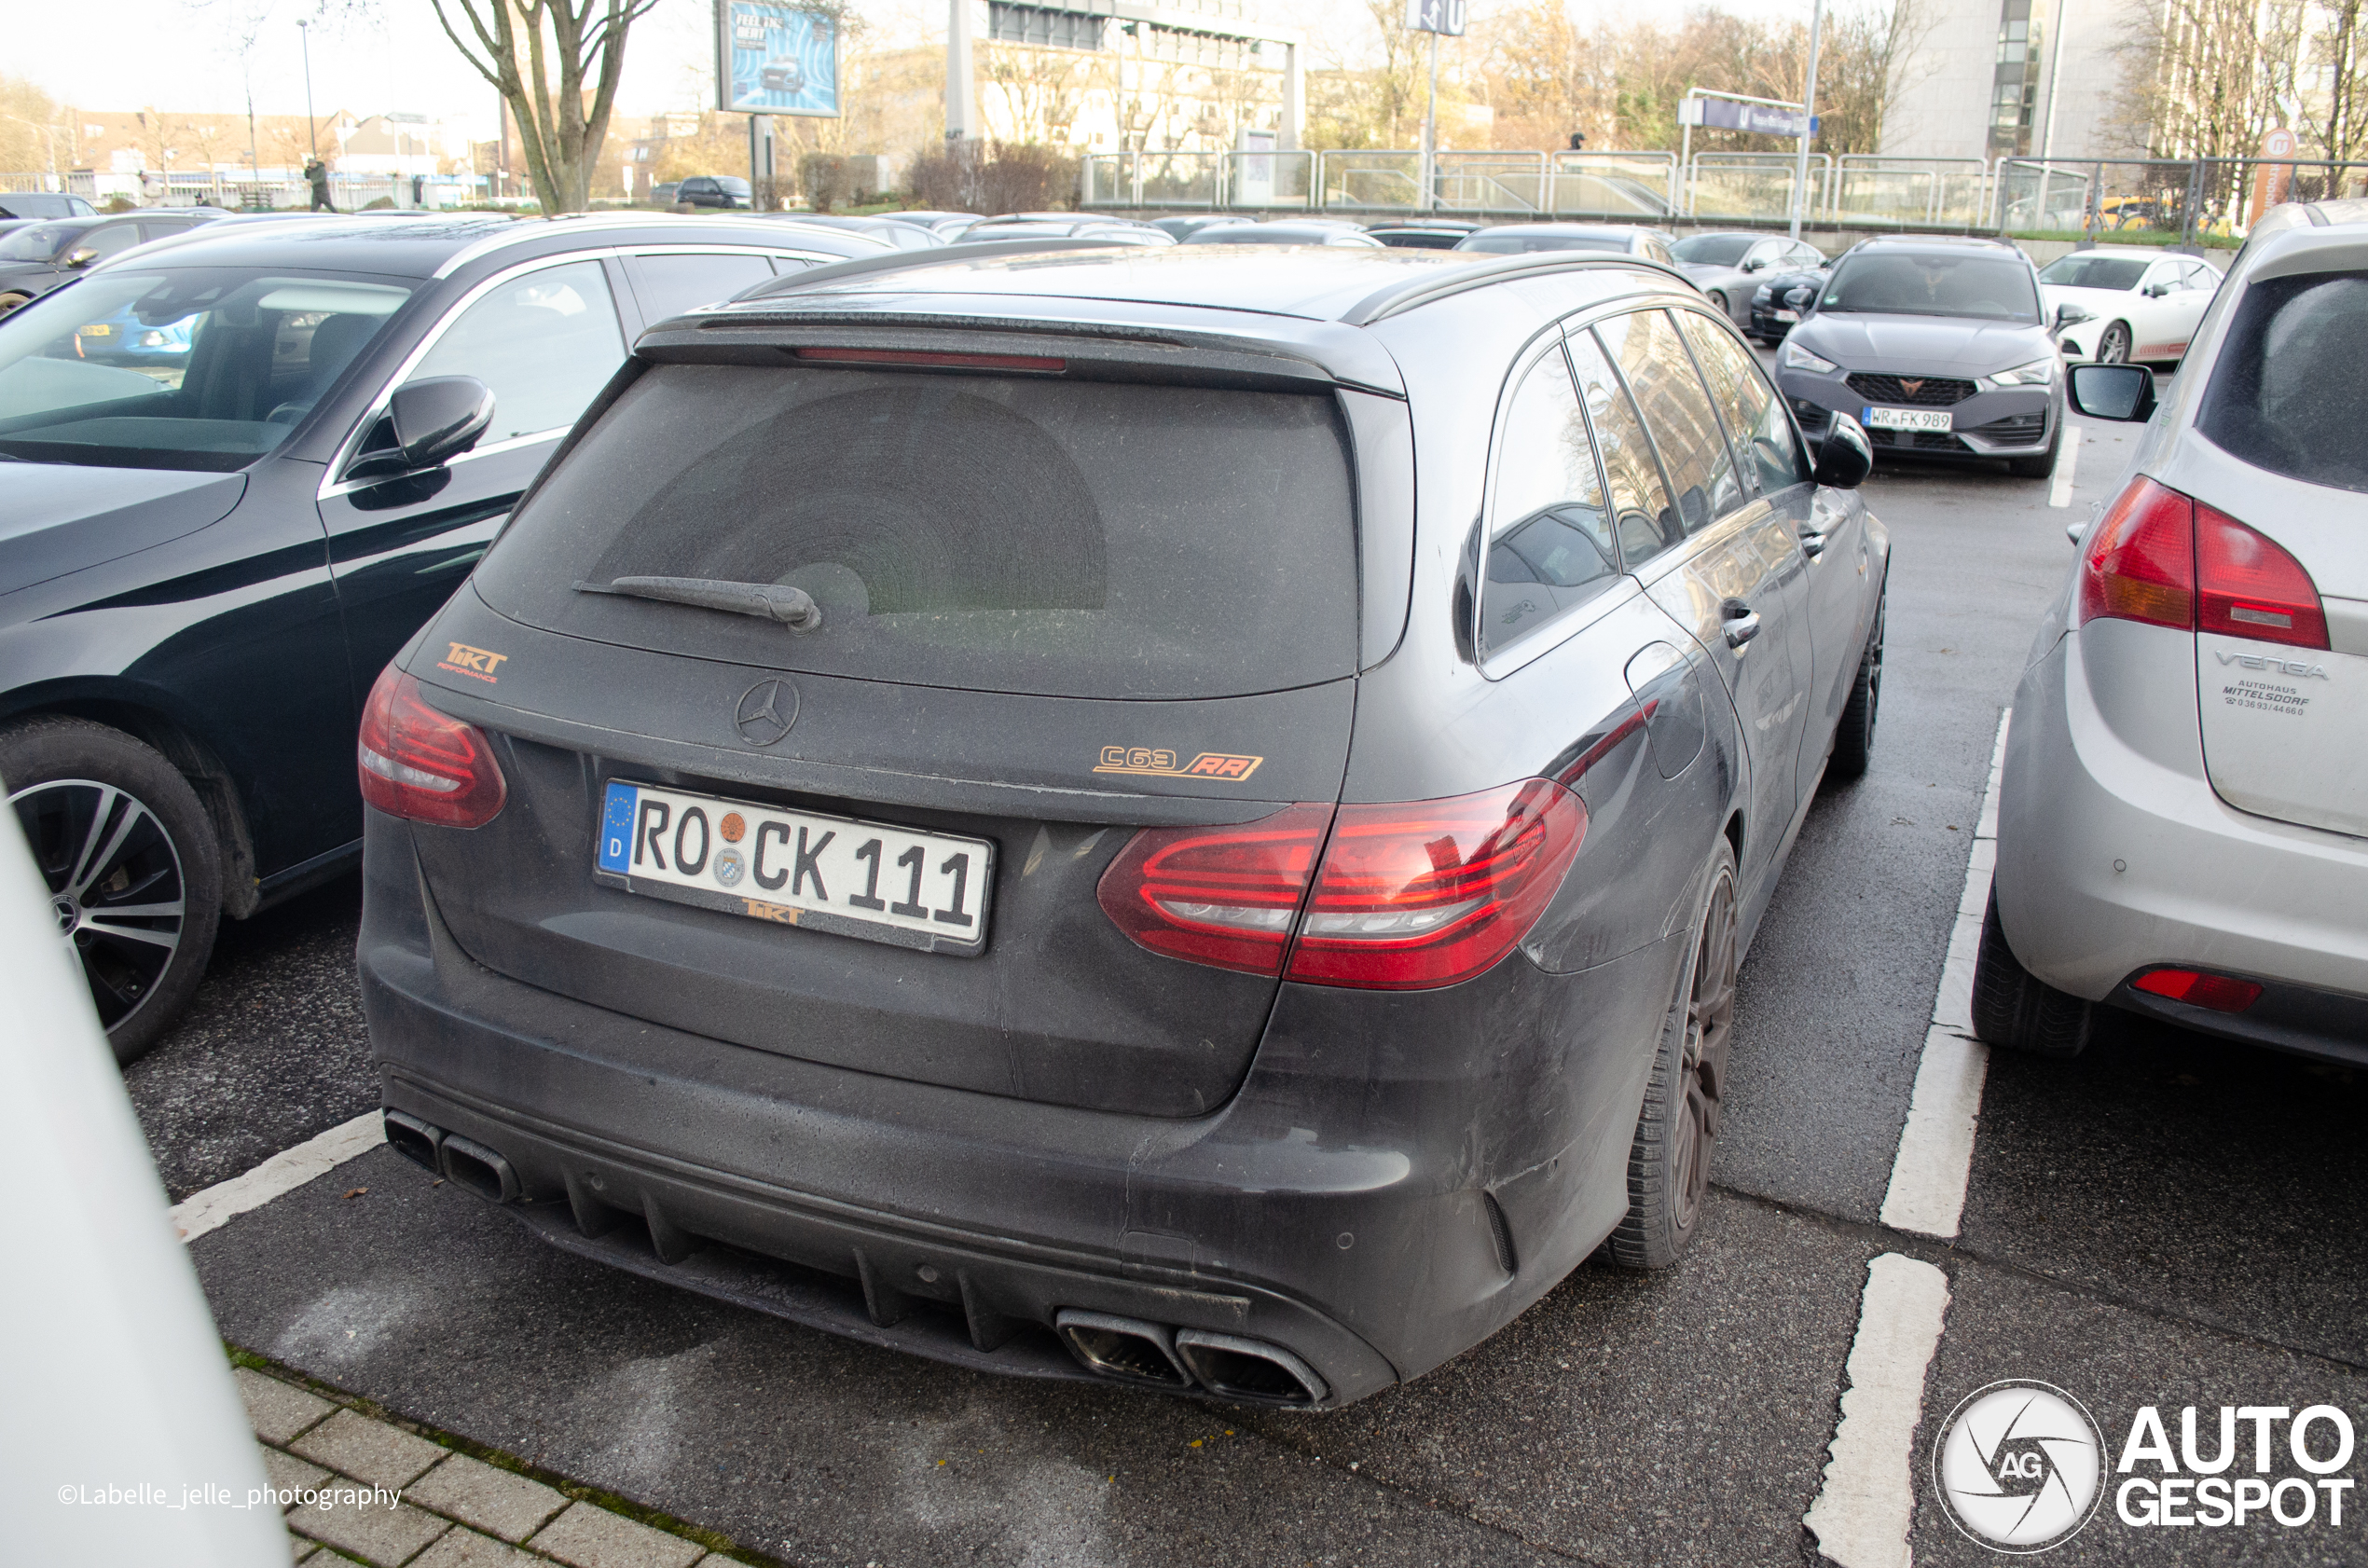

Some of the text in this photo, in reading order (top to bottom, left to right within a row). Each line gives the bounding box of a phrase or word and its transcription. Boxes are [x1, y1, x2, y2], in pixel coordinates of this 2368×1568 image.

[736, 13, 762, 28] FEEL
[736, 26, 765, 40] BEAT
[1740, 107, 1749, 128] U
[1872, 410, 1950, 428] WR FK 989
[436, 662, 498, 683] PERFORMANCE
[2223, 686, 2309, 707] MITTELSDORF
[2238, 680, 2297, 695] AUTOHAUS
[1100, 746, 1249, 777] C63 RR
[610, 837, 622, 857] D
[634, 798, 710, 876] RO
[752, 820, 837, 901] CK
[849, 838, 973, 928] 111
